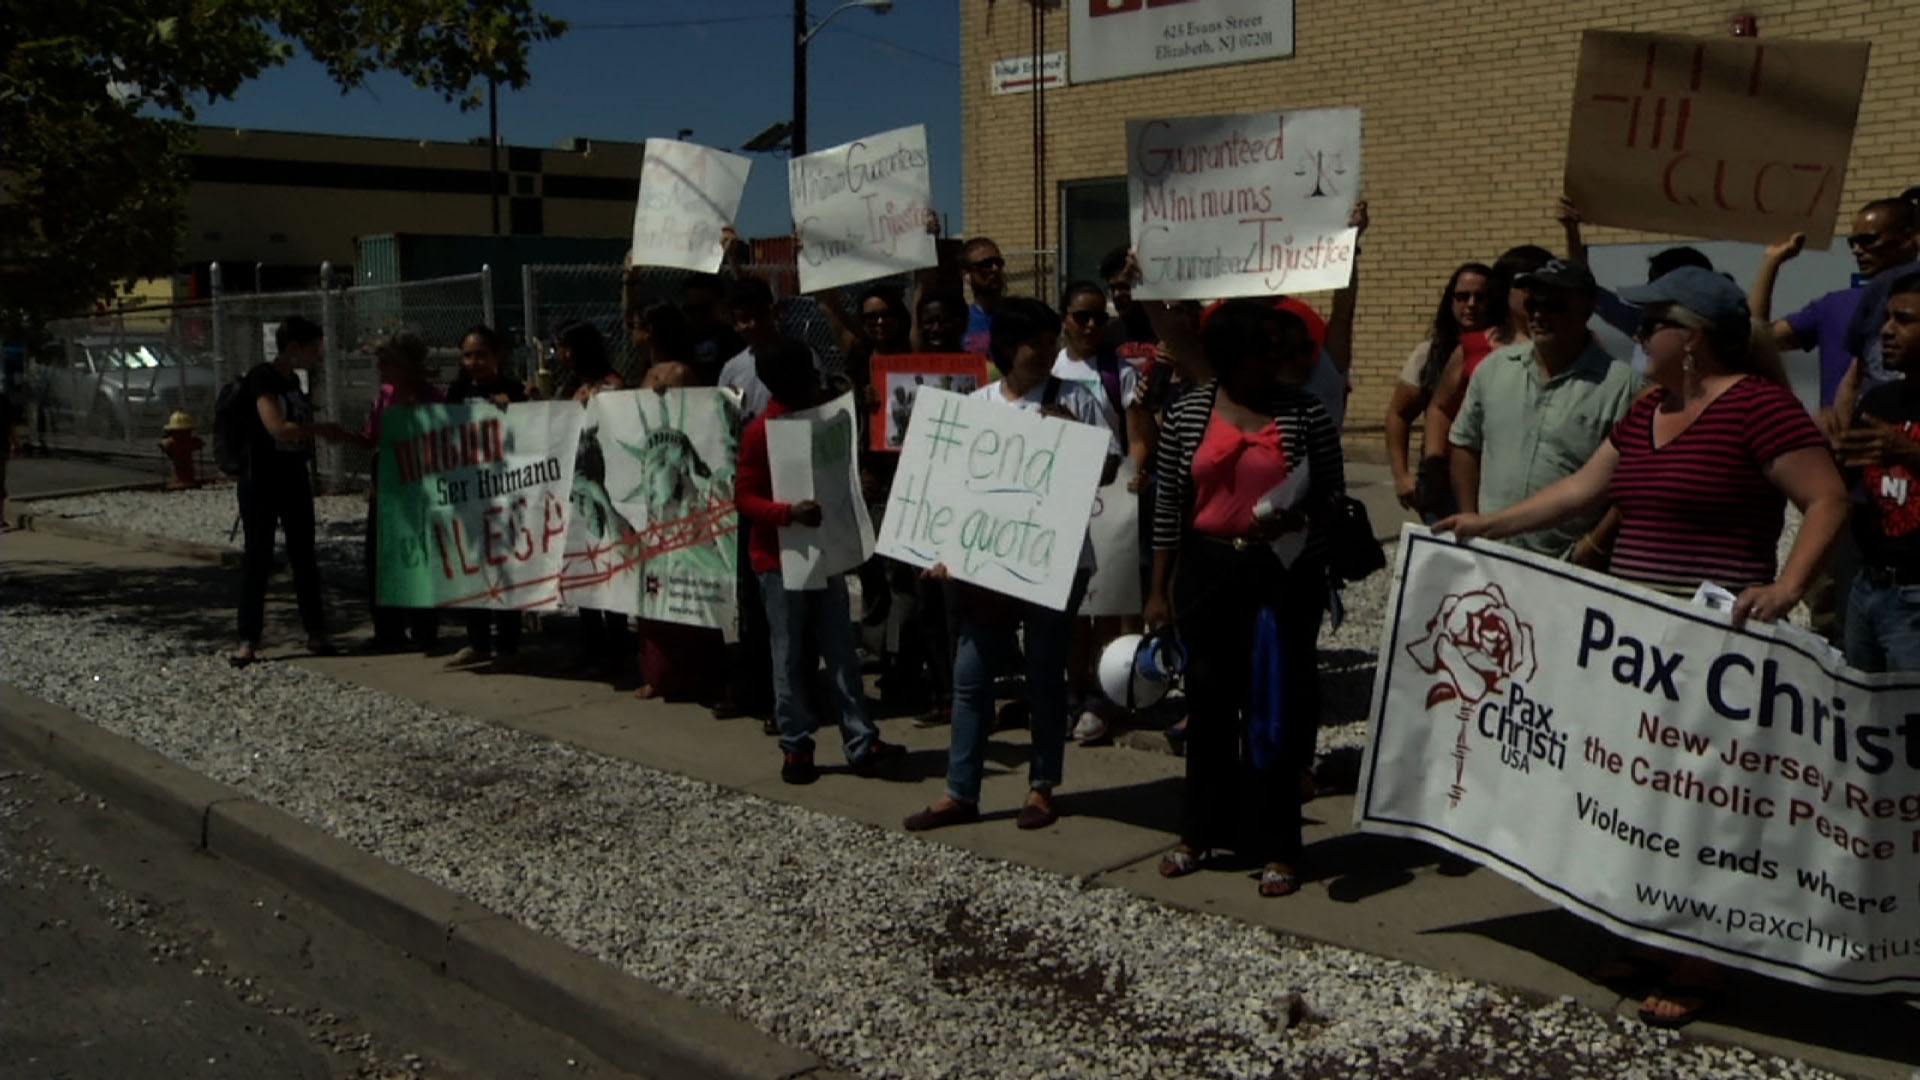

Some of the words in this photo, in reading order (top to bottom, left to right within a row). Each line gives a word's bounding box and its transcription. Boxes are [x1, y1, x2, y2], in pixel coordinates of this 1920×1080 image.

[1186, 21, 1222, 36] Evans
[1224, 15, 1263, 30] Street
[1219, 34, 1236, 52] NJ
[1138, 115, 1284, 177] Guaranteed
[1142, 178, 1273, 223] Minimums
[1238, 217, 1350, 290] Injustice
[924, 400, 1066, 496] #end
[437, 478, 468, 507] Ser
[477, 457, 562, 500] Humano
[1881, 475, 1908, 506] NJ
[896, 464, 954, 543] the
[959, 510, 1058, 575] quota
[1509, 682, 1553, 733] Pax
[1577, 607, 1686, 702] Pax
[1706, 653, 1920, 775] Christ
[1479, 702, 1567, 770] Christi
[1501, 744, 1530, 775] USA
[1638, 711, 1710, 757] New
[1720, 739, 1834, 803] Jersey
[1583, 736, 1624, 775] the
[1630, 757, 1776, 819] Catholic
[1789, 798, 1896, 860] Peace
[1575, 791, 1680, 859] Violence
[1697, 846, 1780, 880] ends
[1796, 867, 1898, 914] where
